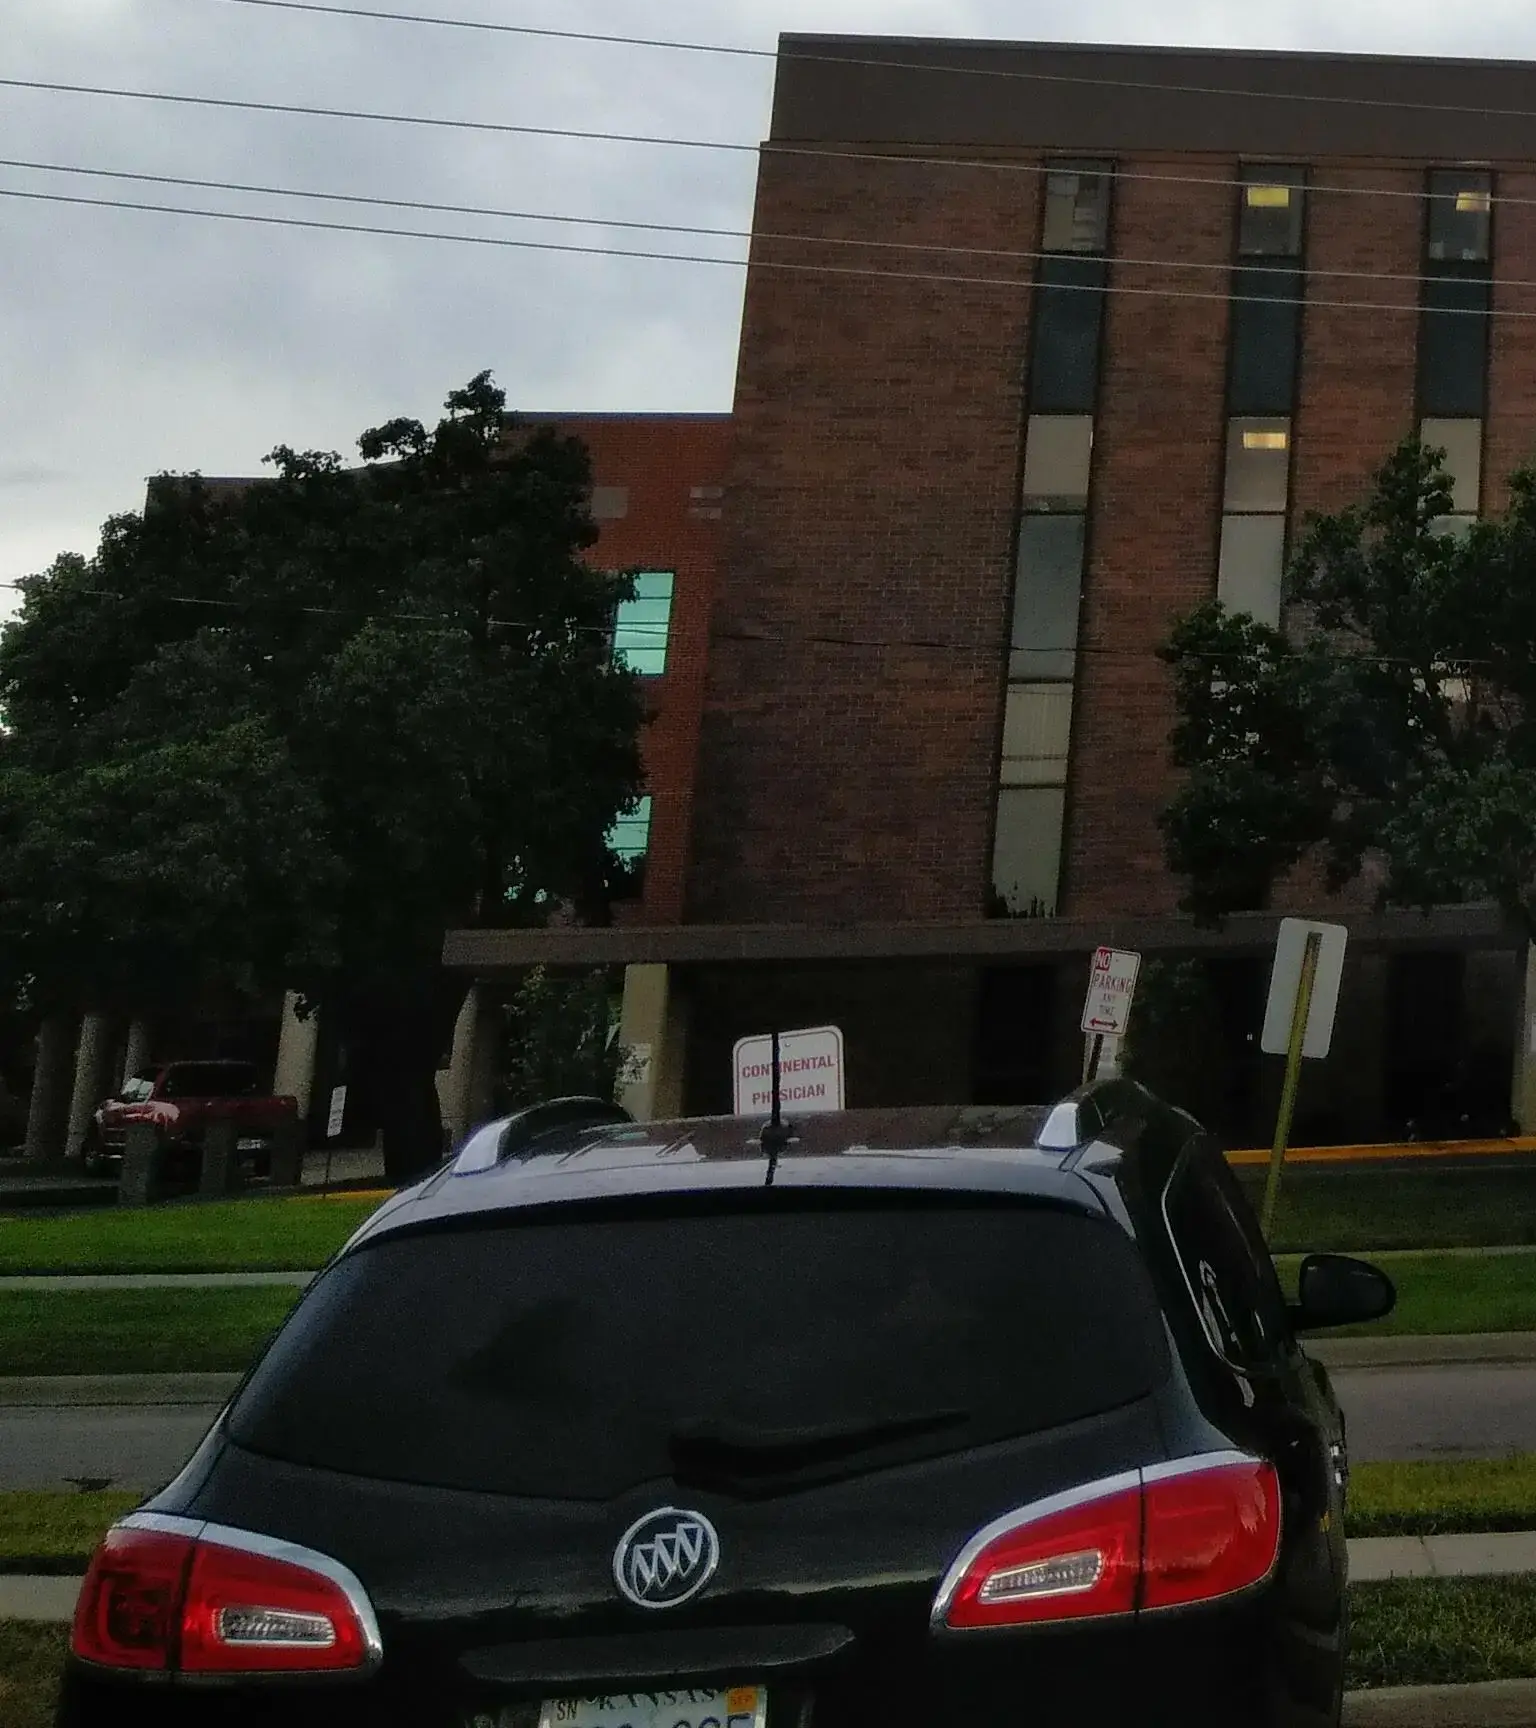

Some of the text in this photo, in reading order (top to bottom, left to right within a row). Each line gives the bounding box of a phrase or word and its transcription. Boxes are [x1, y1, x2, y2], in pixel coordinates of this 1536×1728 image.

[1095, 951, 1111, 968] NO
[1093, 973, 1132, 993] PARKING
[742, 1055, 836, 1078] CONINENTAL
[752, 1083, 826, 1105] PHSICIAN
[556, 1702, 578, 1721] SN
